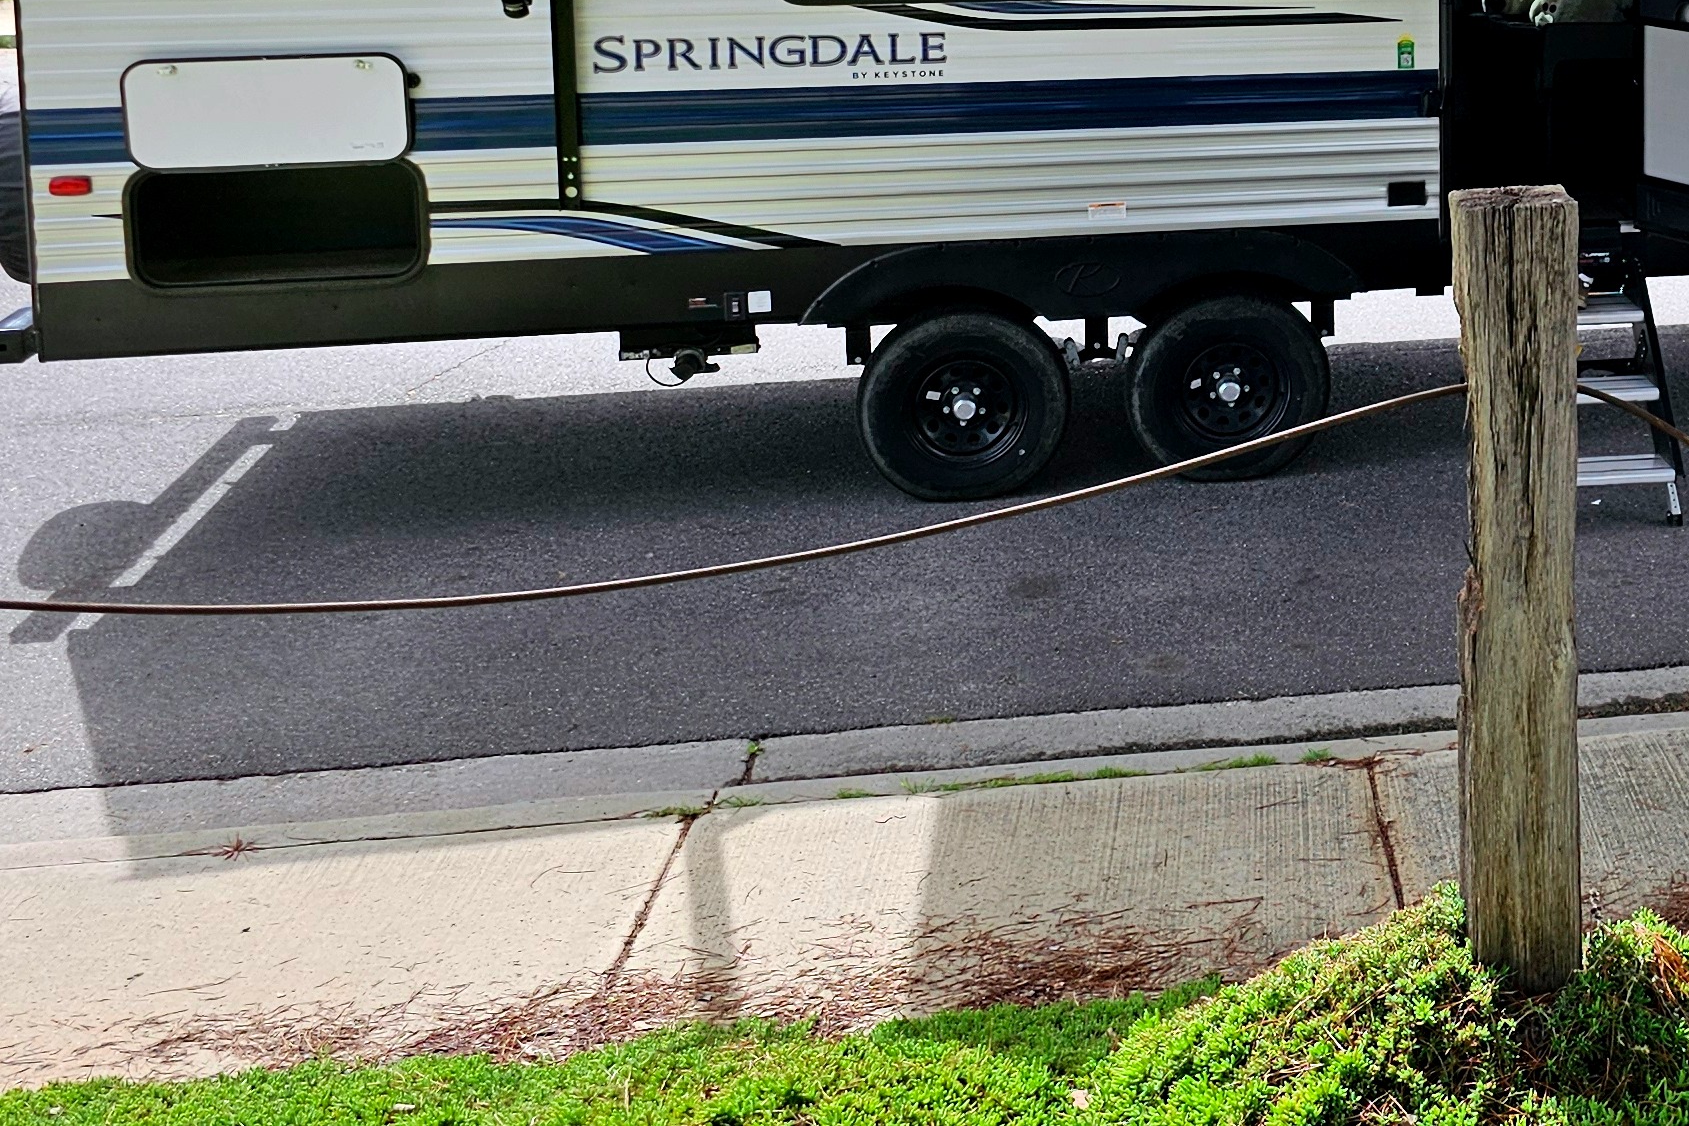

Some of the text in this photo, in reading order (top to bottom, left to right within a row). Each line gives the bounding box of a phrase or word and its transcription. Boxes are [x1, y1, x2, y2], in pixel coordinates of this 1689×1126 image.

[593, 31, 948, 74] SPRINGDALE
[852, 69, 945, 80] BY KEYSTONE
